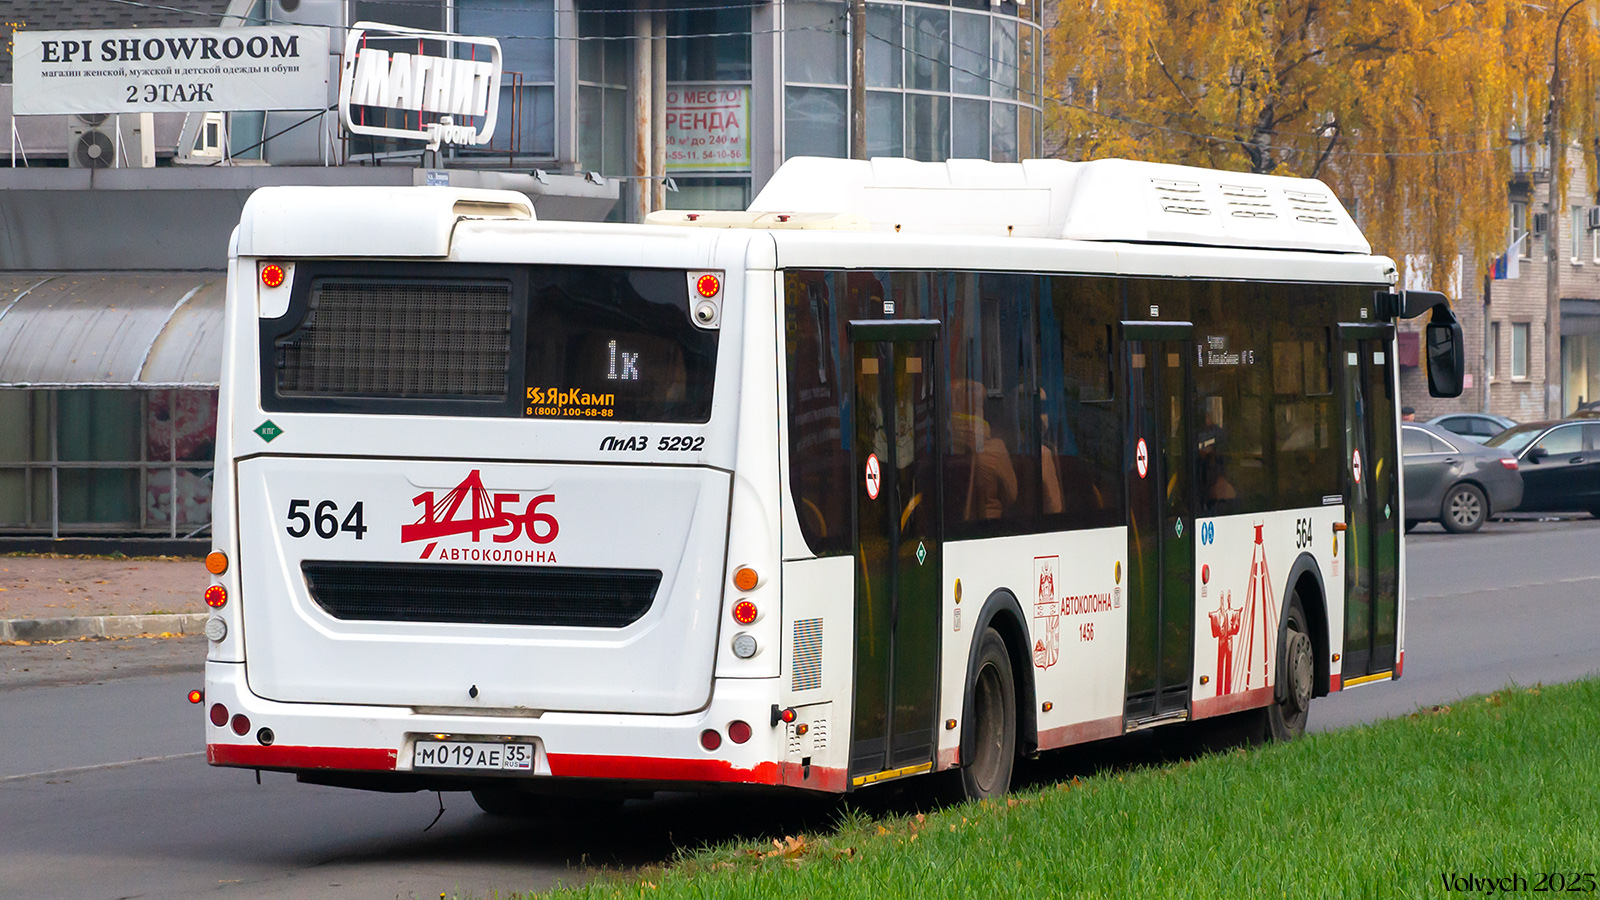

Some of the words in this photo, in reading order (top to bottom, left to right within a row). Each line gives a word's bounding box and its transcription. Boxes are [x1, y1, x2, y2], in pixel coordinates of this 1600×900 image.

[41, 40, 93, 63] EPI
[101, 35, 300, 62] SHOWROOM
[41, 69, 81, 78] магазин
[83, 67, 127, 77] женской,
[129, 66, 172, 78] мужской
[182, 66, 221, 76] детской
[222, 66, 261, 76] одежды
[271, 64, 300, 75] обуви
[350, 48, 494, 117] МАГНИТ
[126, 85, 139, 103] 2
[143, 83, 214, 103] ЭТАЖ
[683, 89, 742, 104] МЕСТО!
[666, 111, 740, 133] РЕНДА
[691, 137, 706, 147] до
[709, 135, 727, 145] 240
[702, 150, 741, 160] 54-10-56
[546, 387, 615, 407] ЯрКамп
[526, 407, 533, 415] 8
[534, 407, 561, 416] (800)
[563, 408, 614, 417] 100-68-88
[599, 436, 649, 451] ЛиАЗ
[657, 436, 705, 451] 5292
[401, 470, 559, 544] 1456
[285, 499, 368, 540] 564
[1295, 517, 1313, 549] 564
[439, 548, 558, 563] АВТОКОЛОННА
[1060, 593, 1112, 616] АВТОКОЛОННА
[1079, 622, 1095, 642] 1456
[506, 746, 525, 761] 35
